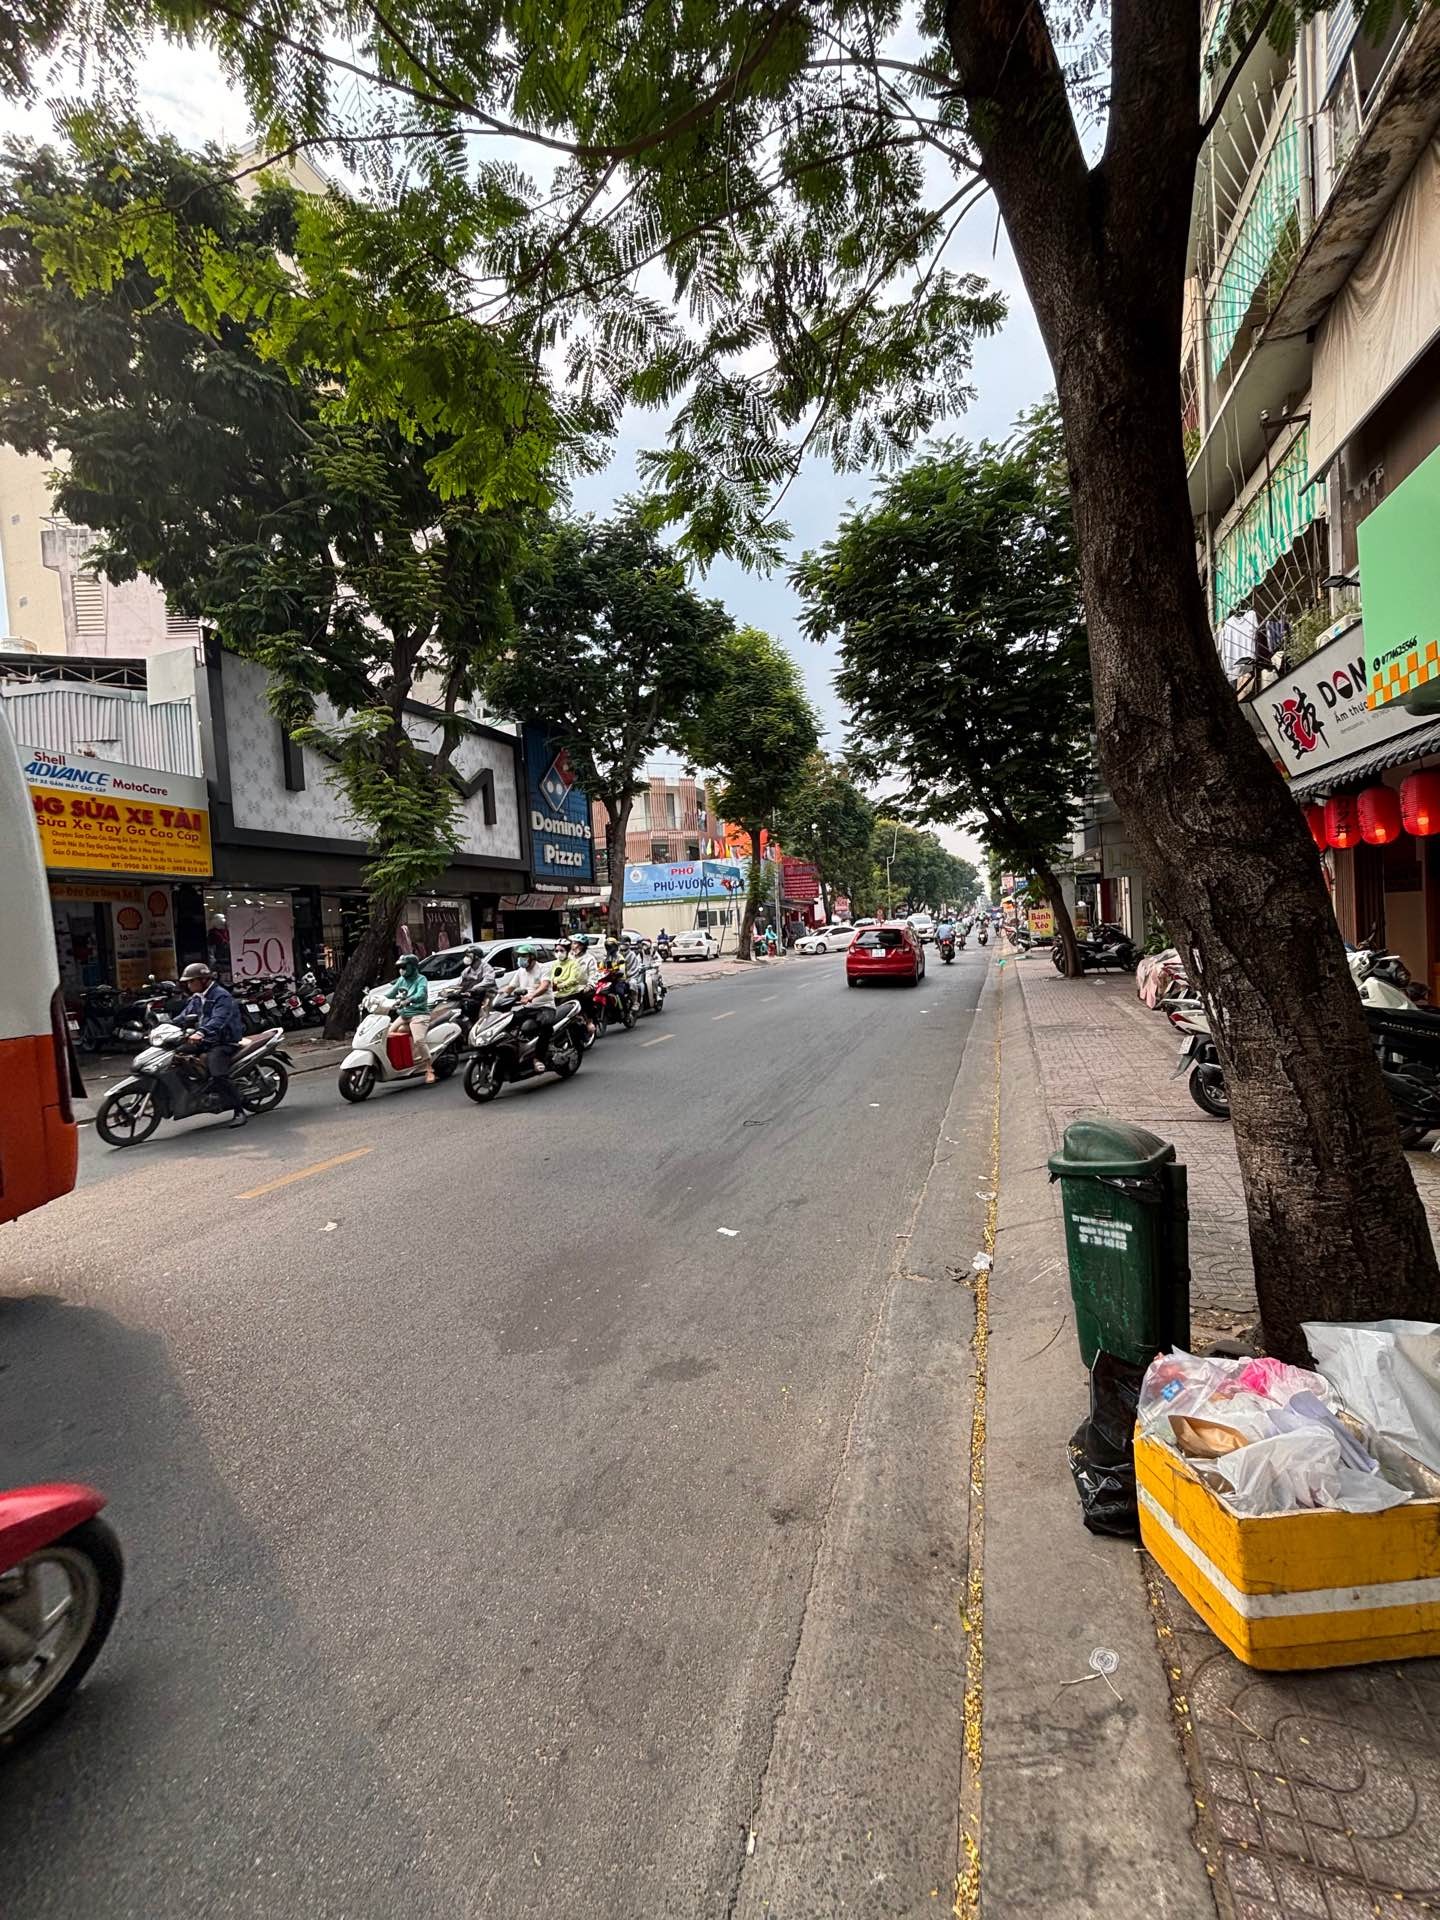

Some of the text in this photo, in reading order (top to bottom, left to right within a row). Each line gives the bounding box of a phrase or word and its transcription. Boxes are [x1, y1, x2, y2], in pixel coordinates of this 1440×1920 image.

[34, 752, 66, 765] Shell
[24, 761, 111, 786] ADVANCE
[112, 778, 168, 796] MotoCare
[70, 798, 119, 823] SỬA
[126, 807, 154, 826] XE
[72, 819, 92, 831] Xe
[96, 821, 122, 836] Tay
[126, 824, 146, 837] Ga
[150, 827, 173, 839] Cao
[531, 810, 591, 839] Domino's
[544, 844, 583, 867] Pizza
[670, 863, 694, 876] PHỞ
[1031, 911, 1051, 921] Bánh
[1034, 921, 1049, 930] Xèo
